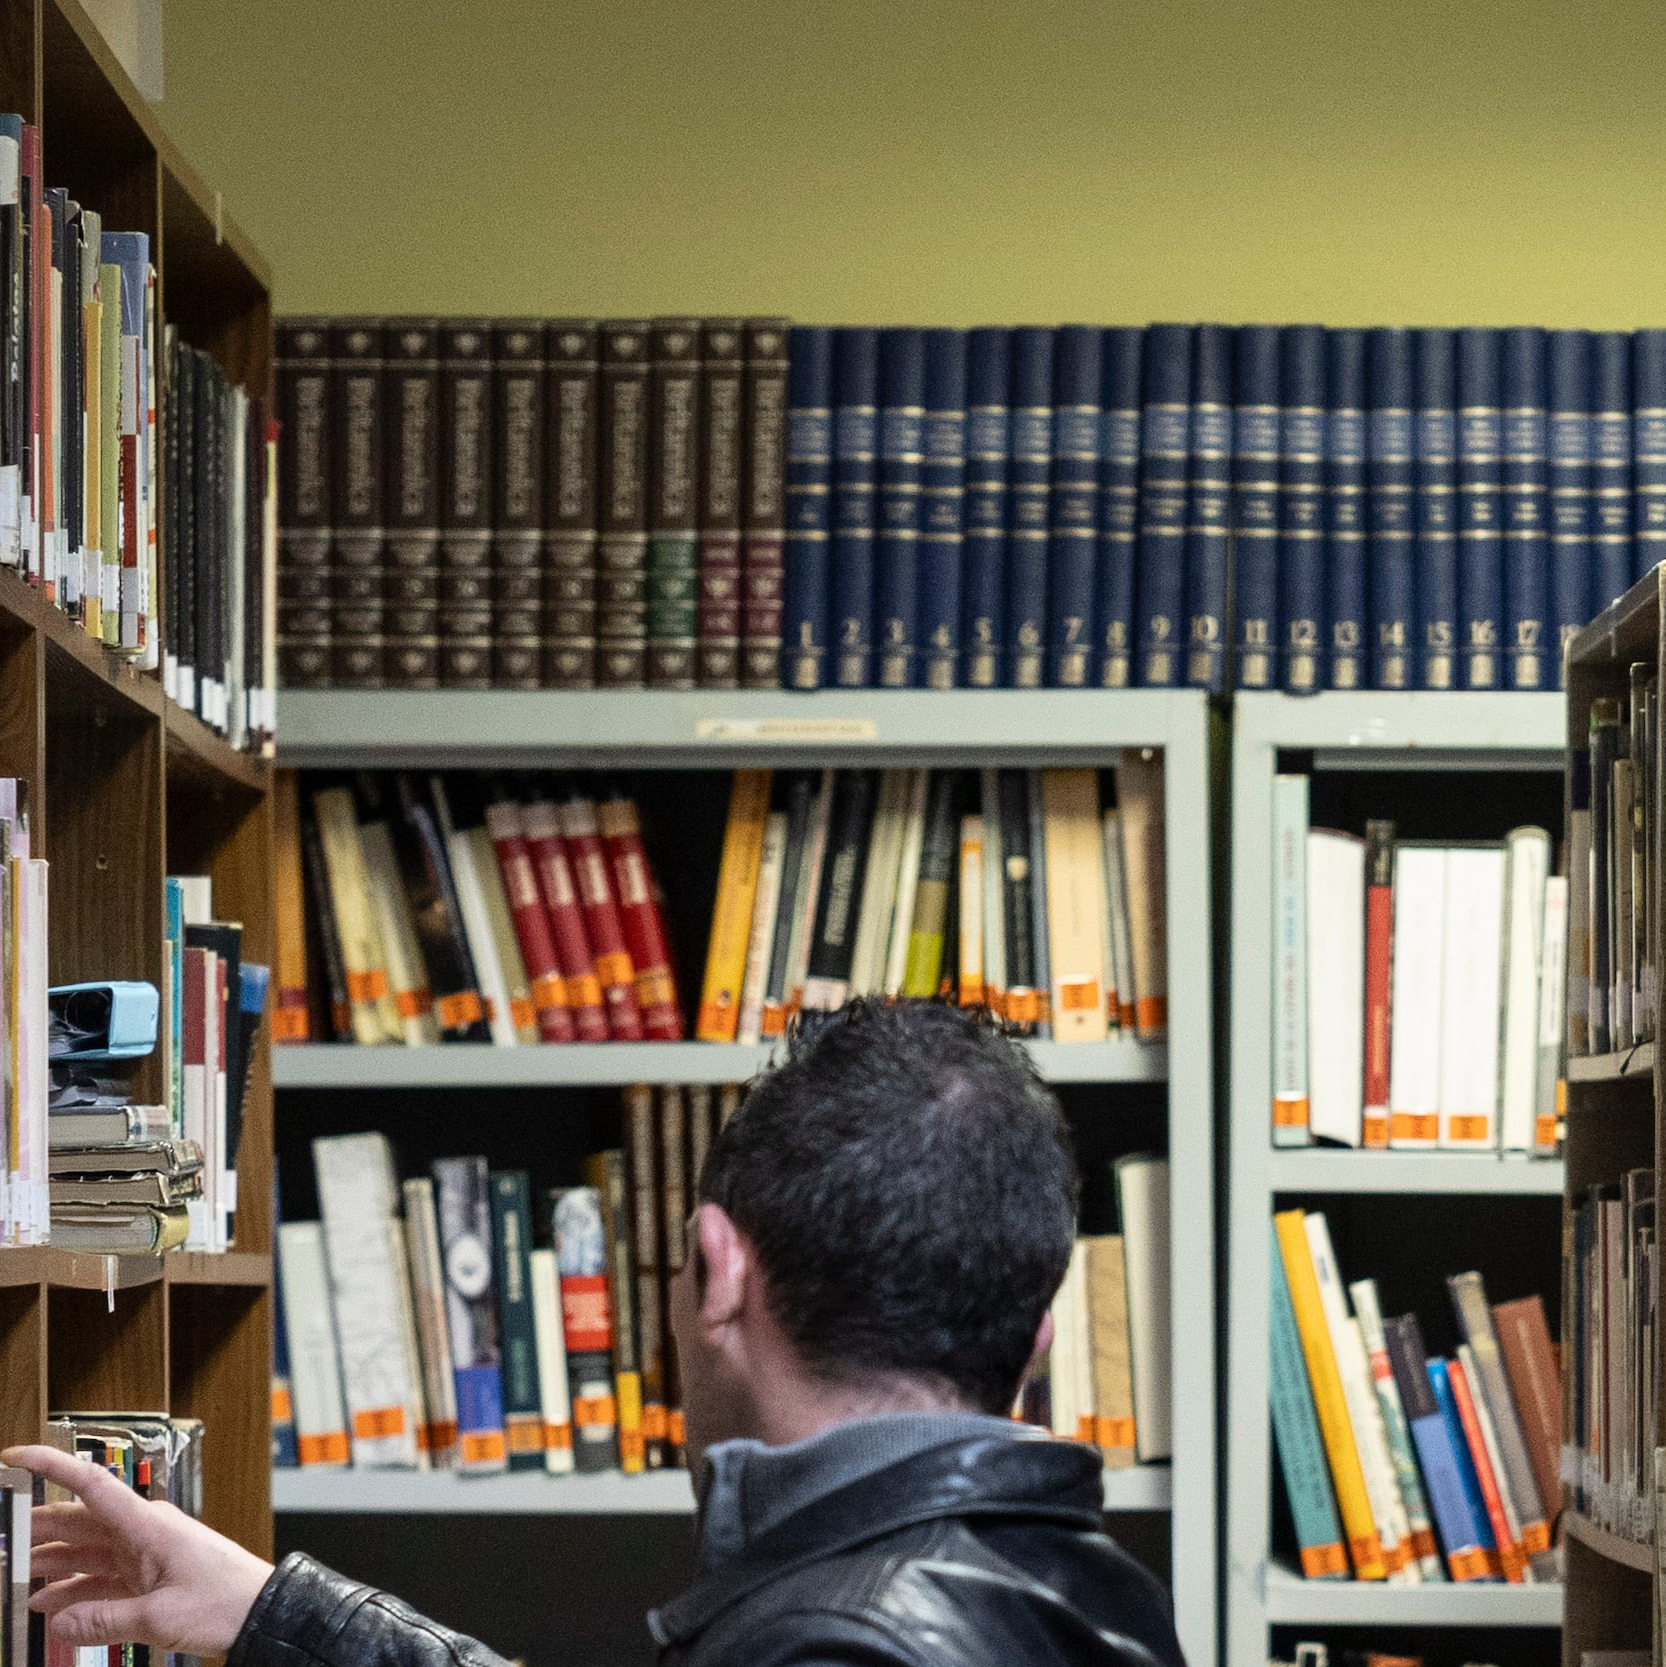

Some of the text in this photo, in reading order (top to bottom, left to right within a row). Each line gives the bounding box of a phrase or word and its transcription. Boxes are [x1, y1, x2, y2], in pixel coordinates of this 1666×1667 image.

[798, 619, 815, 647] 1
[842, 617, 861, 645] 2
[887, 617, 904, 645] 3
[931, 624, 949, 648] 4
[974, 617, 992, 645] 5
[1017, 622, 1040, 647] 6
[1063, 616, 1084, 645] 7
[1106, 620, 1127, 648] 8
[1151, 615, 1171, 642] 9
[1190, 615, 1220, 642] 10
[1244, 618, 1268, 645] 11
[1289, 619, 1317, 646] 12
[1333, 619, 1360, 648] 13
[1379, 621, 1406, 646] 14
[1426, 619, 1452, 646] 15
[1469, 619, 1497, 646] 16
[1516, 619, 1542, 645] 17
